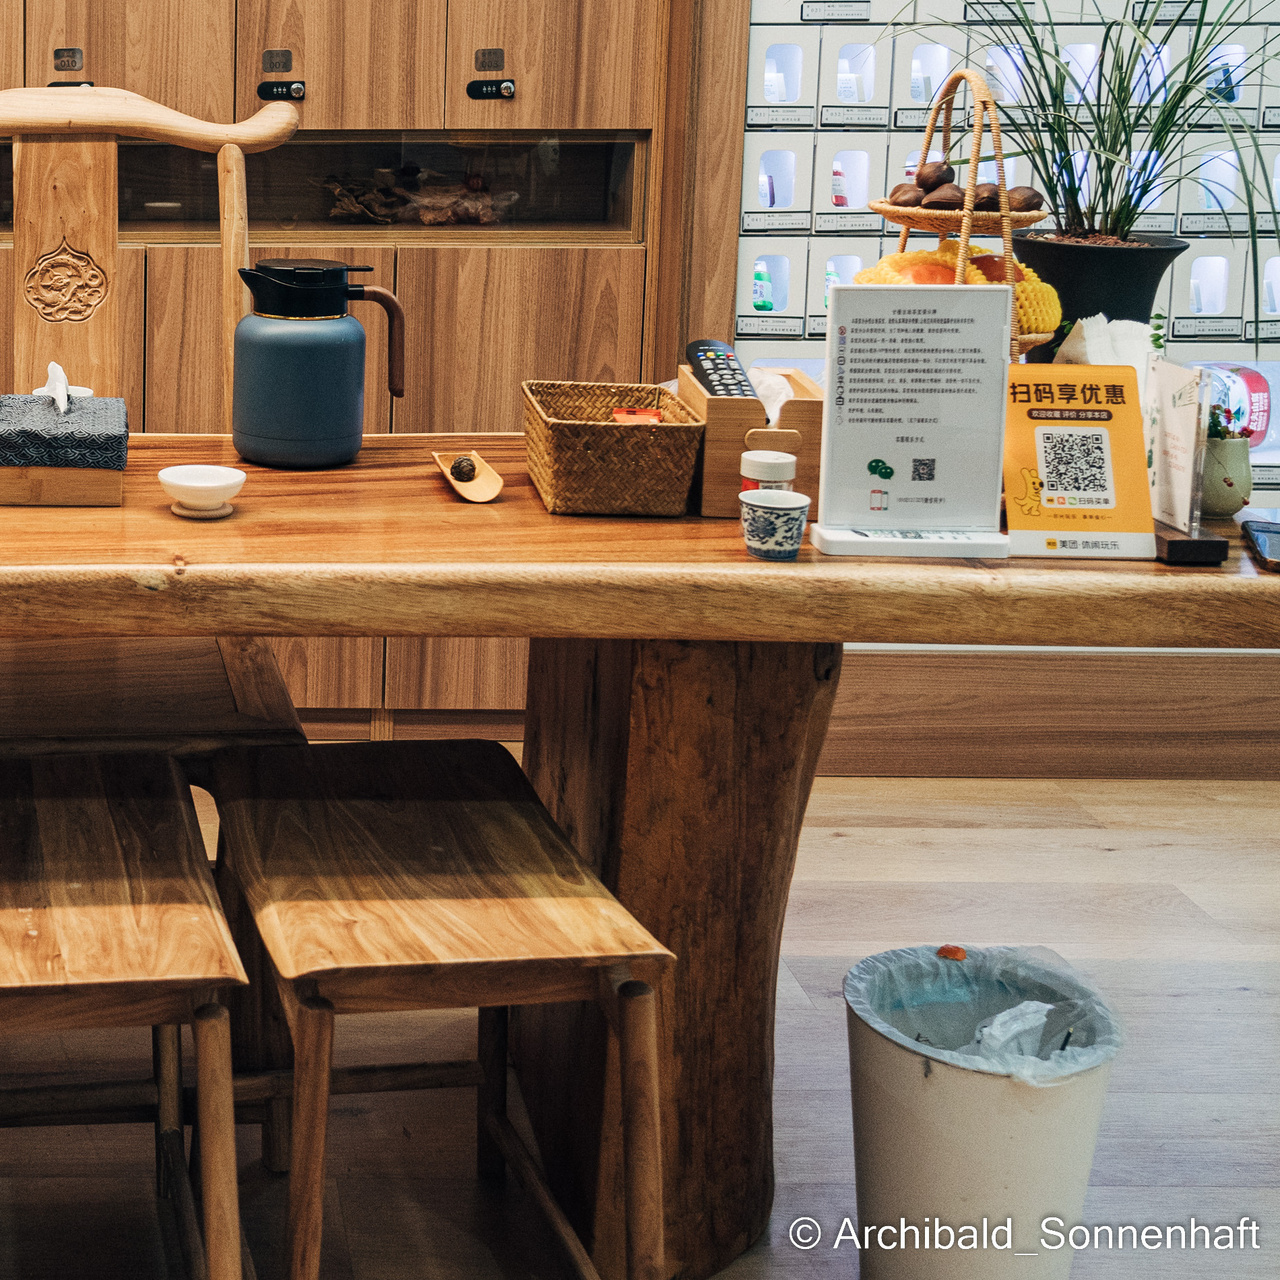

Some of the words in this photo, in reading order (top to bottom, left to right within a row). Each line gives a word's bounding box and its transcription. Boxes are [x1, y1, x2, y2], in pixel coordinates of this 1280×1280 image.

[60, 60, 77, 68] 010
[1009, 382, 1127, 405] 扫码享优惠
[1031, 410, 1060, 418] 欢迎收藏
[1078, 497, 1110, 505] 扫码买单
[1059, 540, 1120, 550] 美团·休闲玩乐
